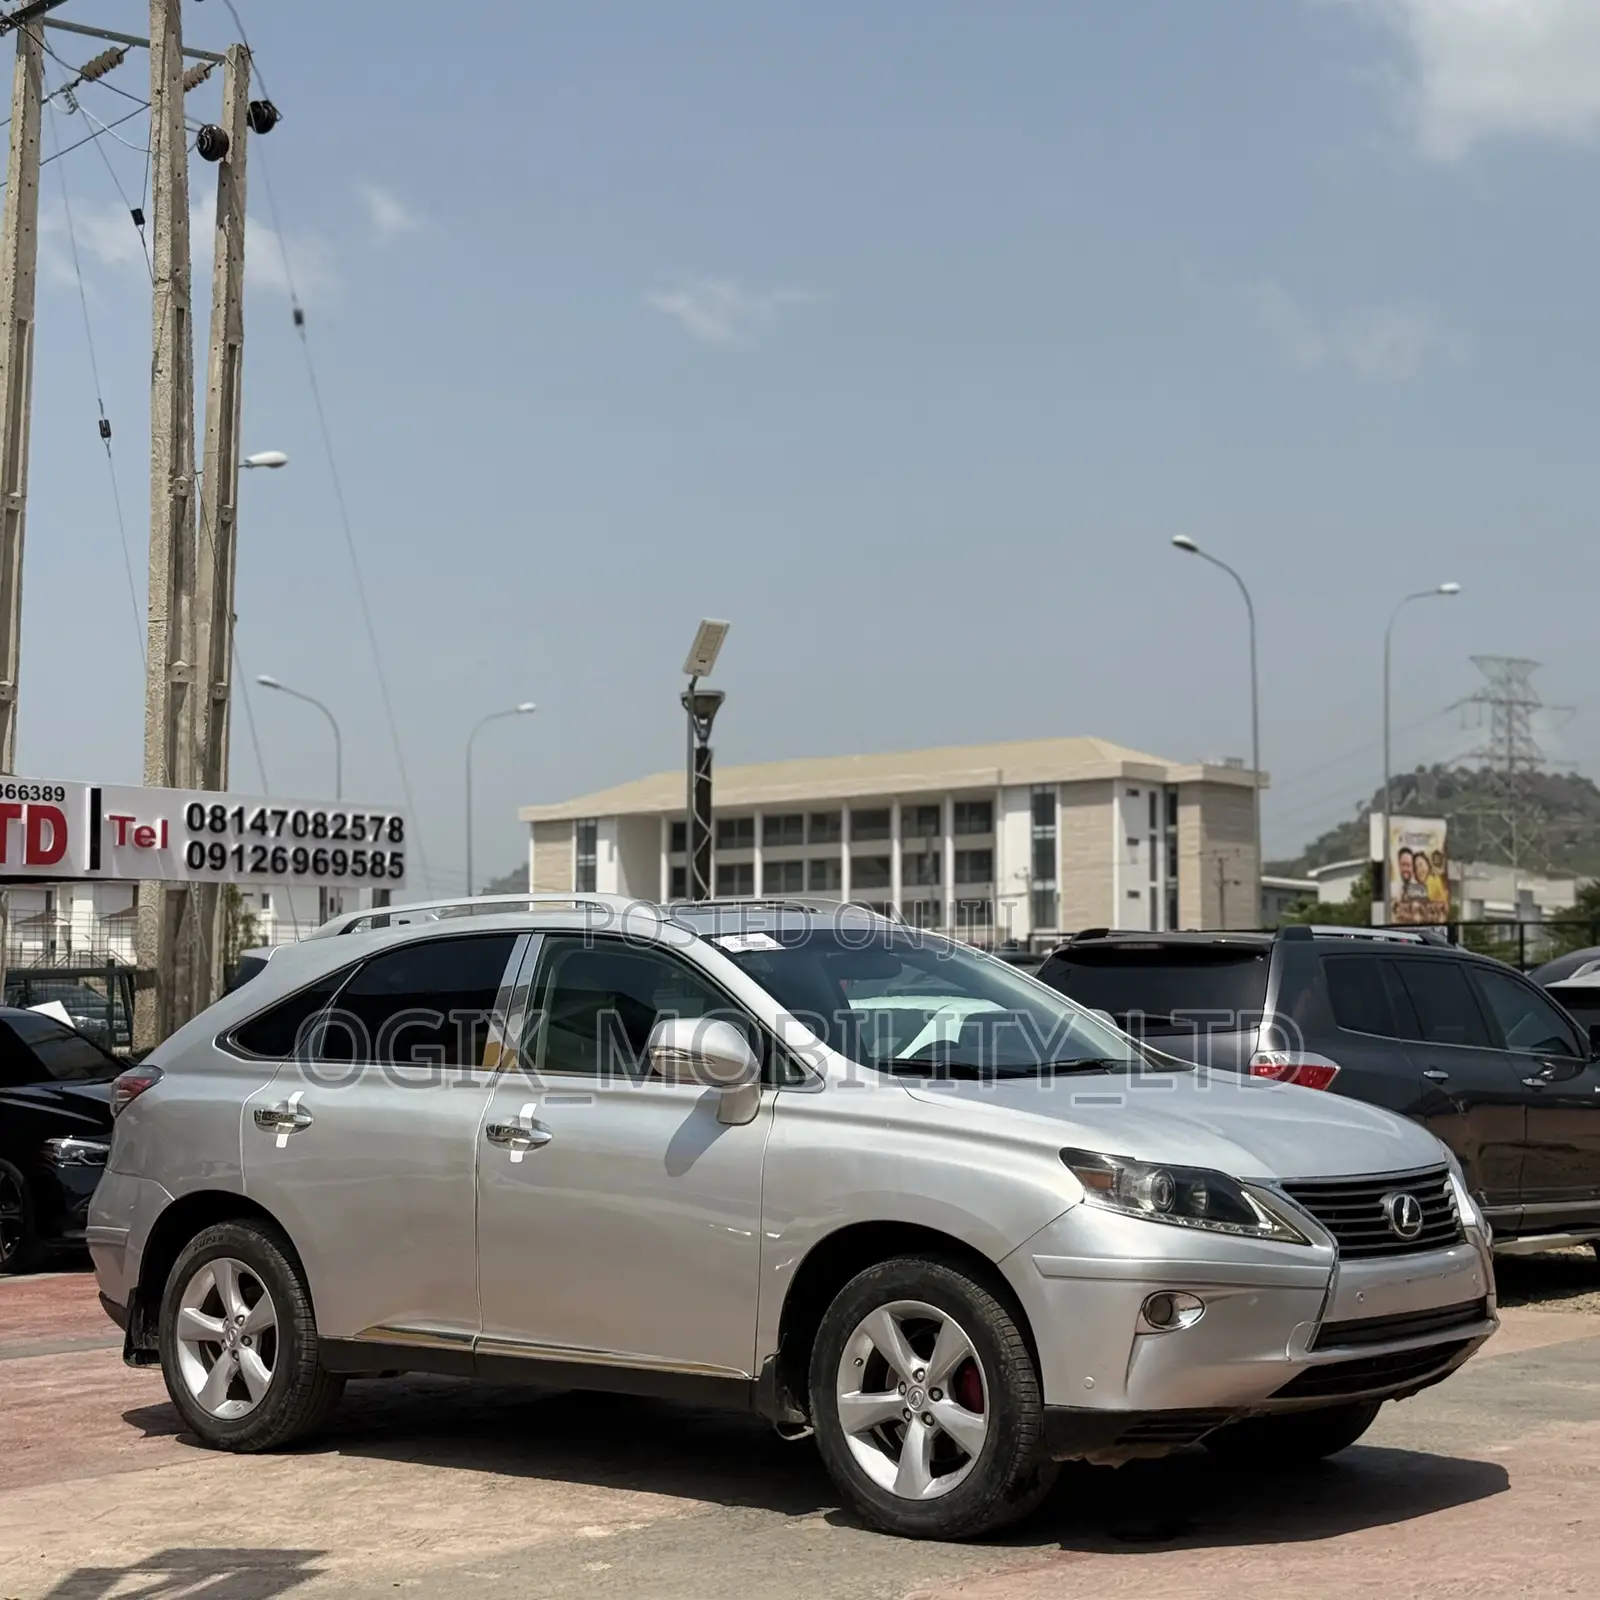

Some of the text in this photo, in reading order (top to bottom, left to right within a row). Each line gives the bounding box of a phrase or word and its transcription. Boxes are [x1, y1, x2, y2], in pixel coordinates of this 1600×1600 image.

[106, 814, 168, 849] Tel
[186, 802, 404, 843] 08147082578
[186, 841, 404, 879] 09126969585
